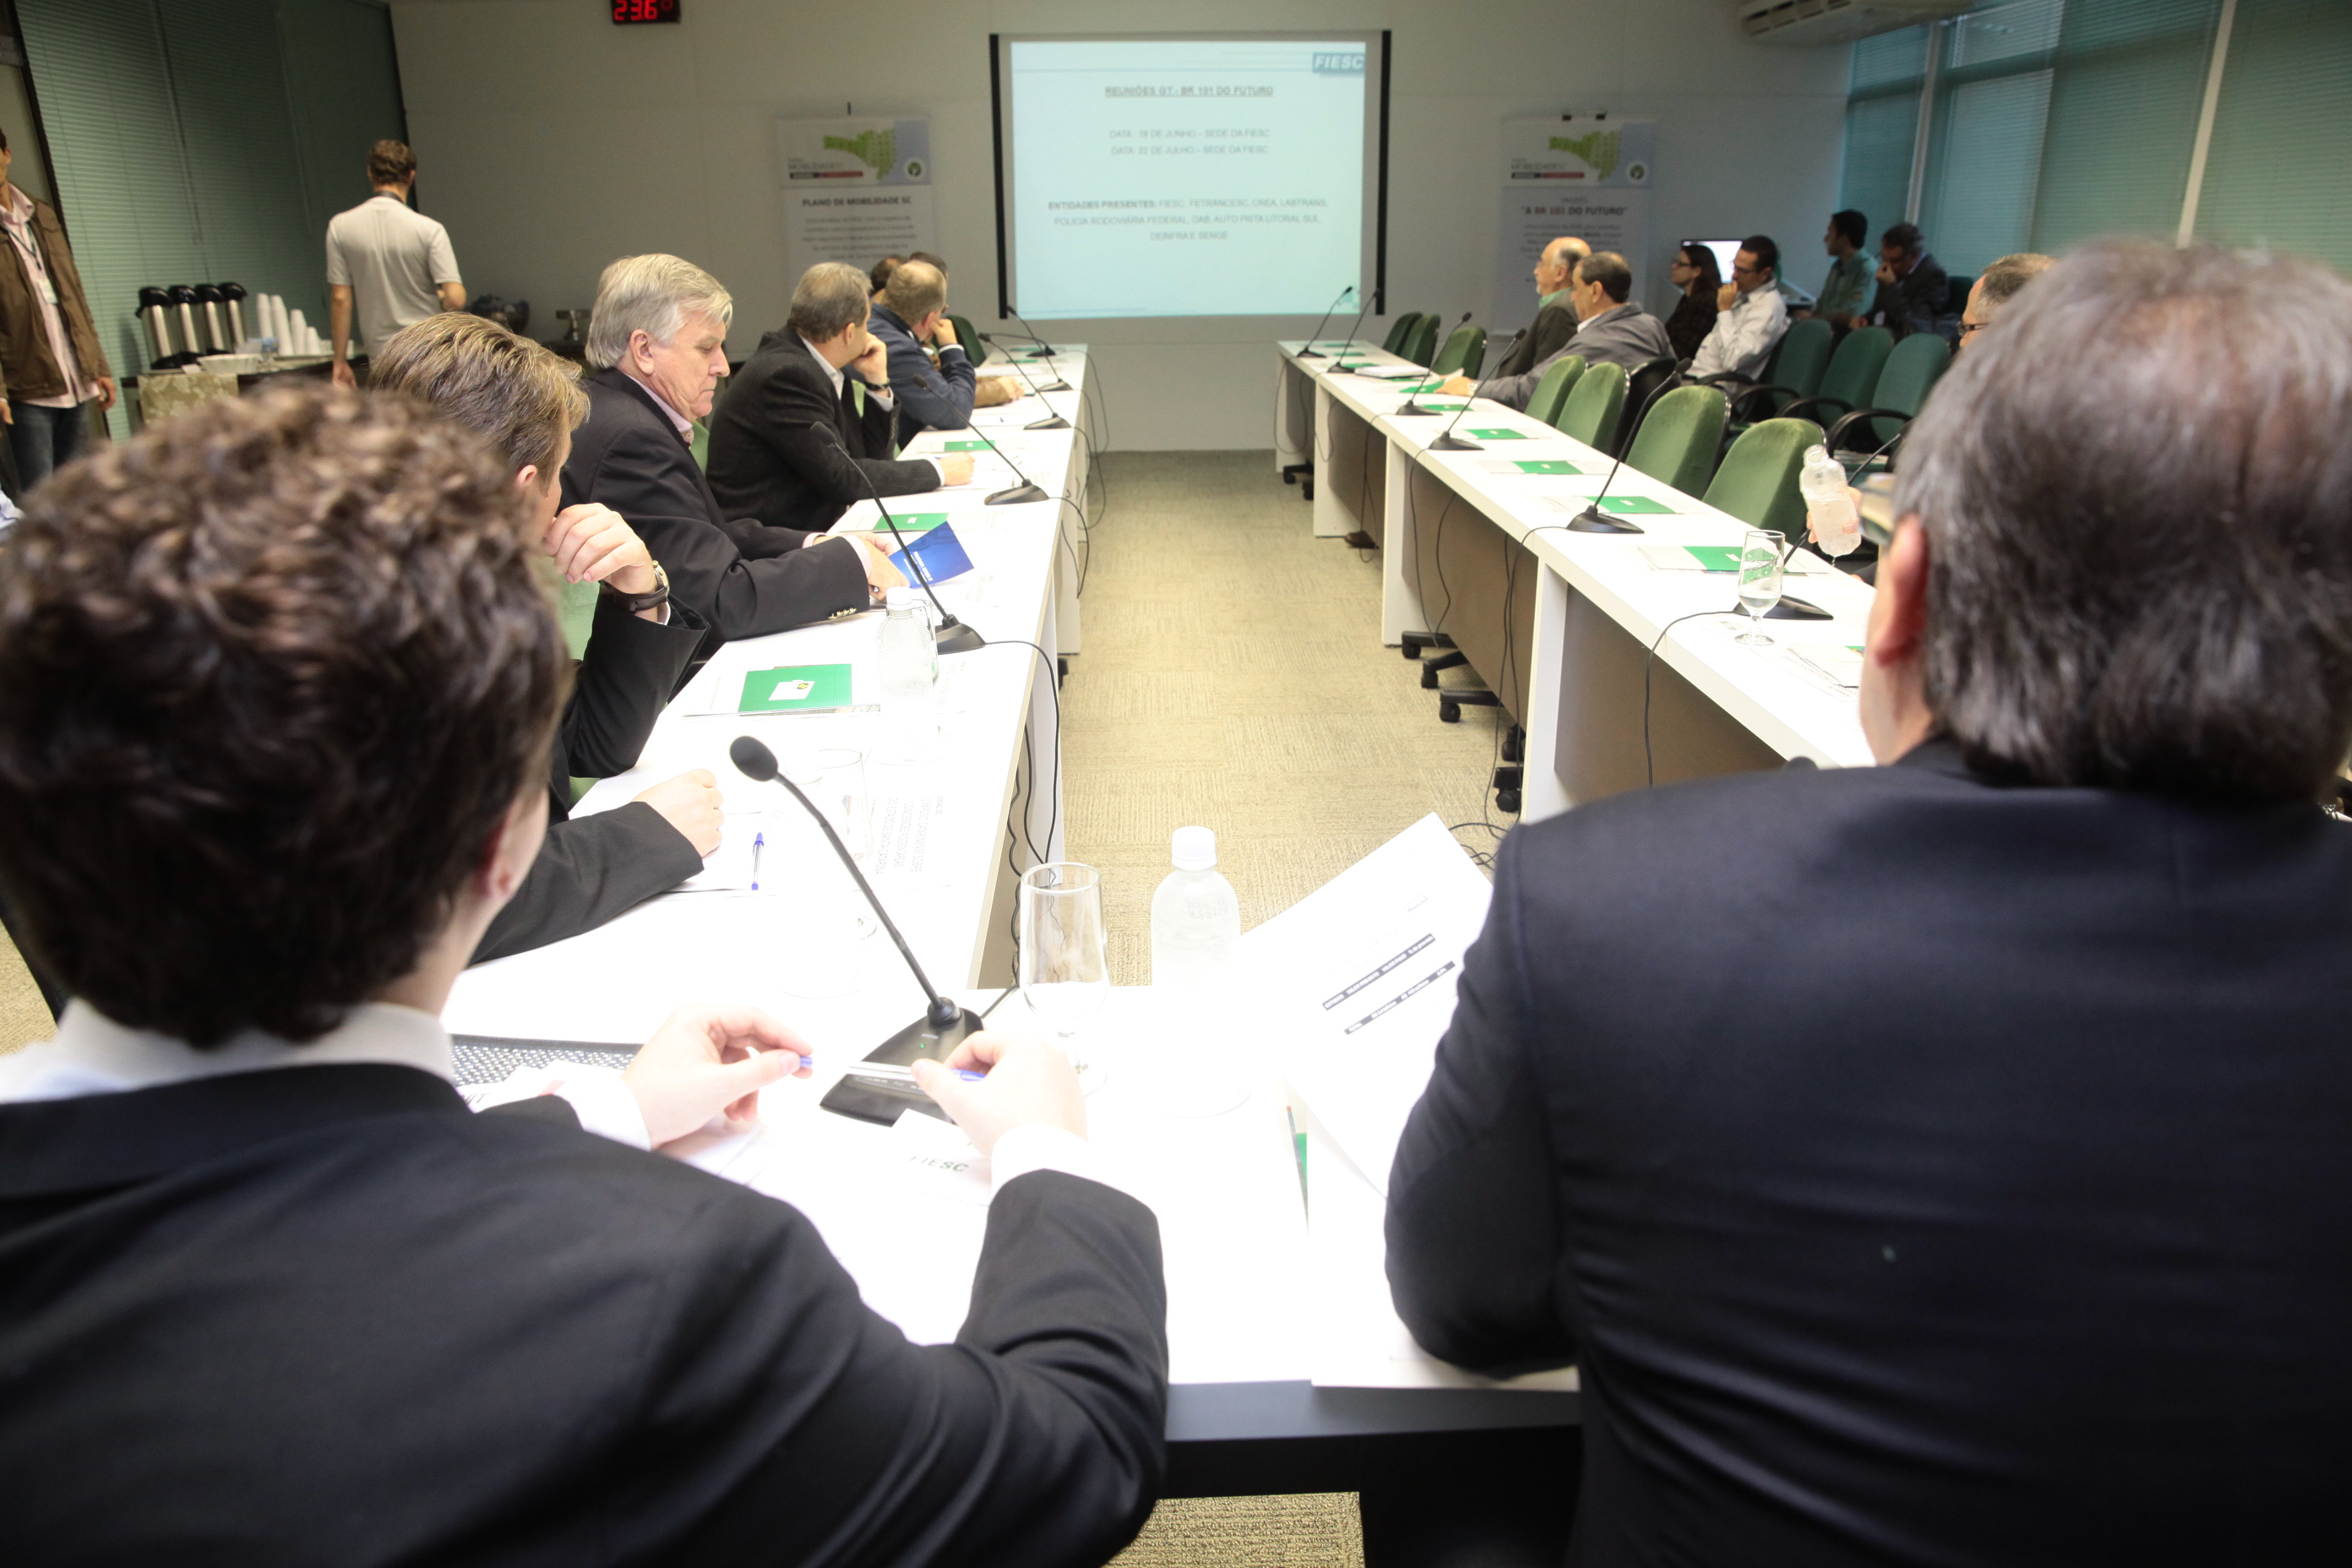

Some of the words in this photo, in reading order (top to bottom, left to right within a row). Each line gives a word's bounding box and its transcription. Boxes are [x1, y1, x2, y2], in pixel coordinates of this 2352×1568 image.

[1315, 55, 1364, 69] FIESC
[1217, 86, 1230, 97] DO
[1233, 86, 1273, 97] FUTURO
[1150, 129, 1162, 139] DE
[1205, 128, 1227, 138] SEDE
[1150, 145, 1162, 155] DE
[1203, 145, 1225, 155] SEDE
[1048, 200, 1099, 210] ENTIDADES
[1568, 206, 1582, 215] DO
[885, 806, 897, 824] ESTADO
[879, 832, 892, 849] SANTA
[874, 849, 889, 874] CATARINA
[911, 856, 923, 873] SOBRE
[909, 1155, 969, 1172] FIESC
